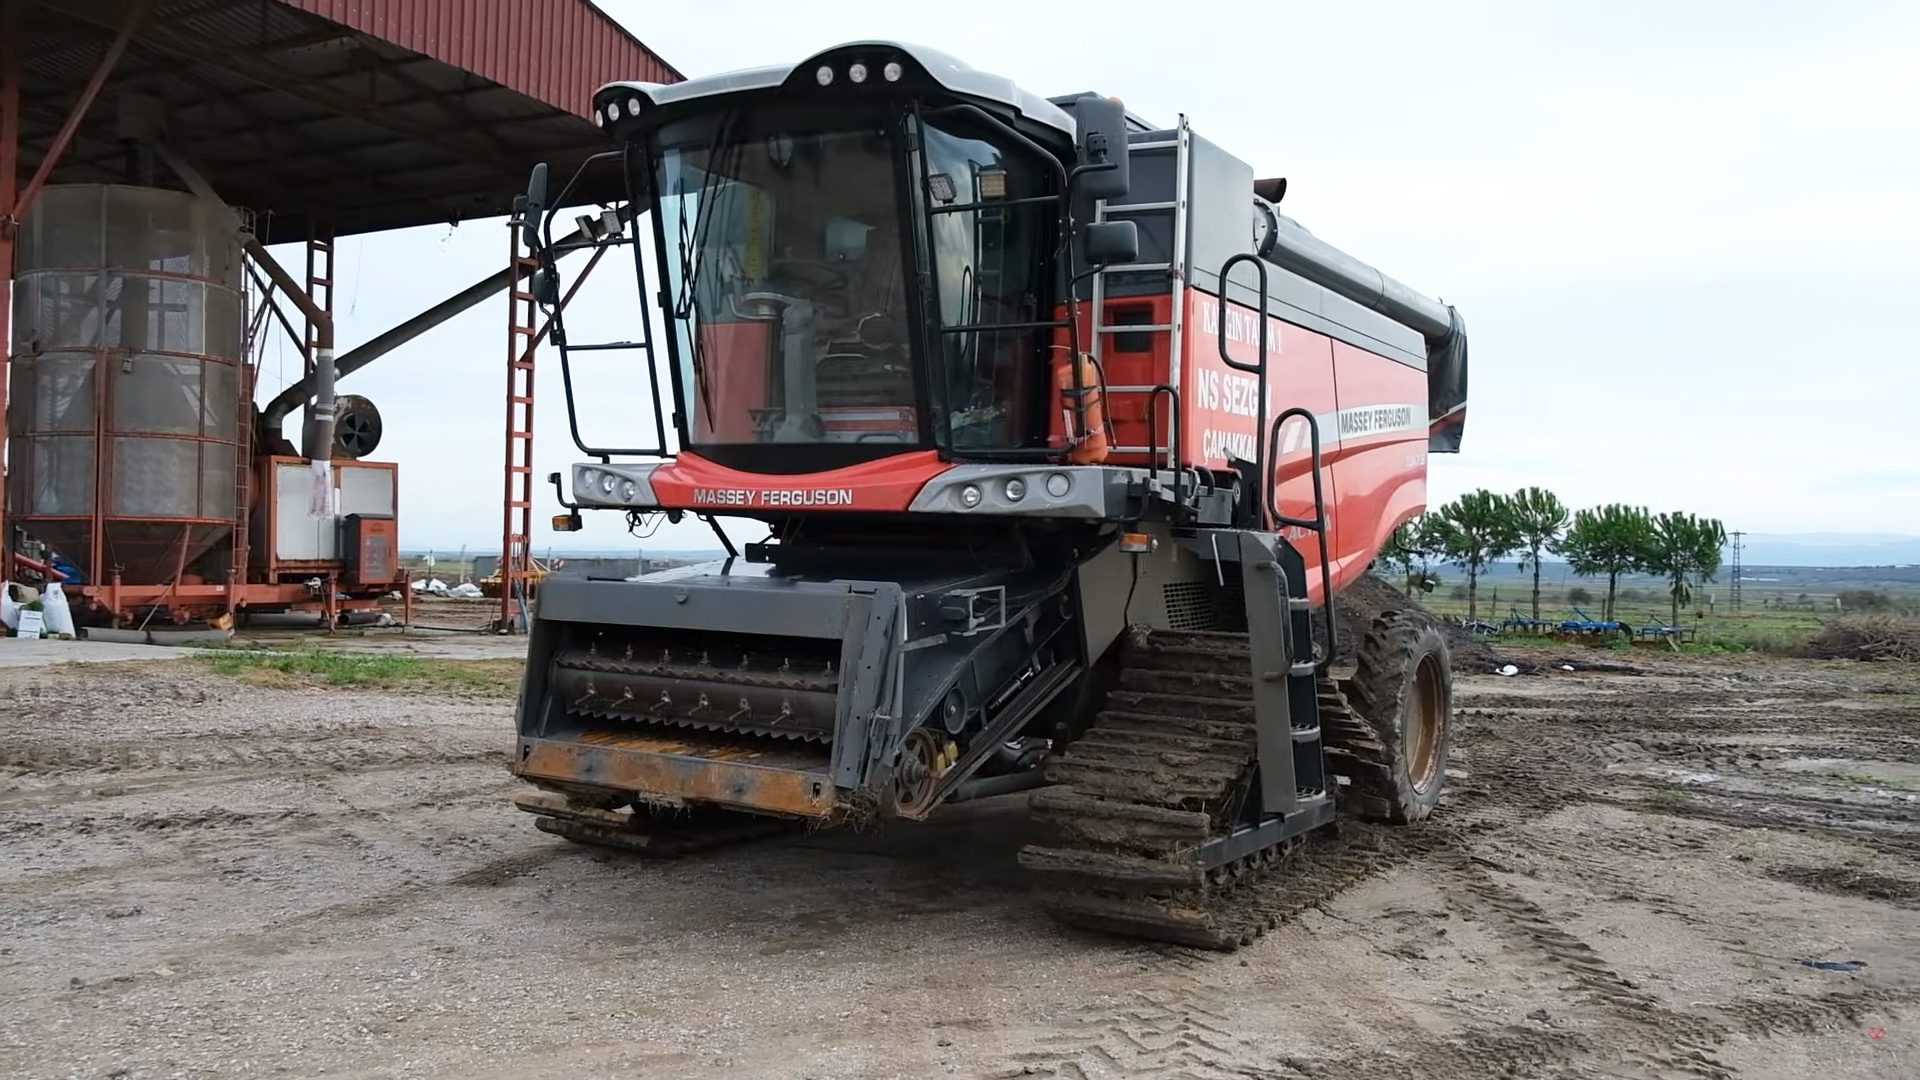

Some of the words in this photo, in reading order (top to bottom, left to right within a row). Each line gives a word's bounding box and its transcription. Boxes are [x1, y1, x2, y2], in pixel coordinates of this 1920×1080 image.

[1198, 367, 1219, 411] NS
[1223, 373, 1272, 420] SEZGN
[1341, 410, 1373, 434] MASSEY
[1374, 407, 1412, 429] FERGUSON
[1203, 428, 1258, 465] ÇANAKKAL
[693, 488, 757, 505] MASSEY
[760, 489, 853, 505] FERGUSON
